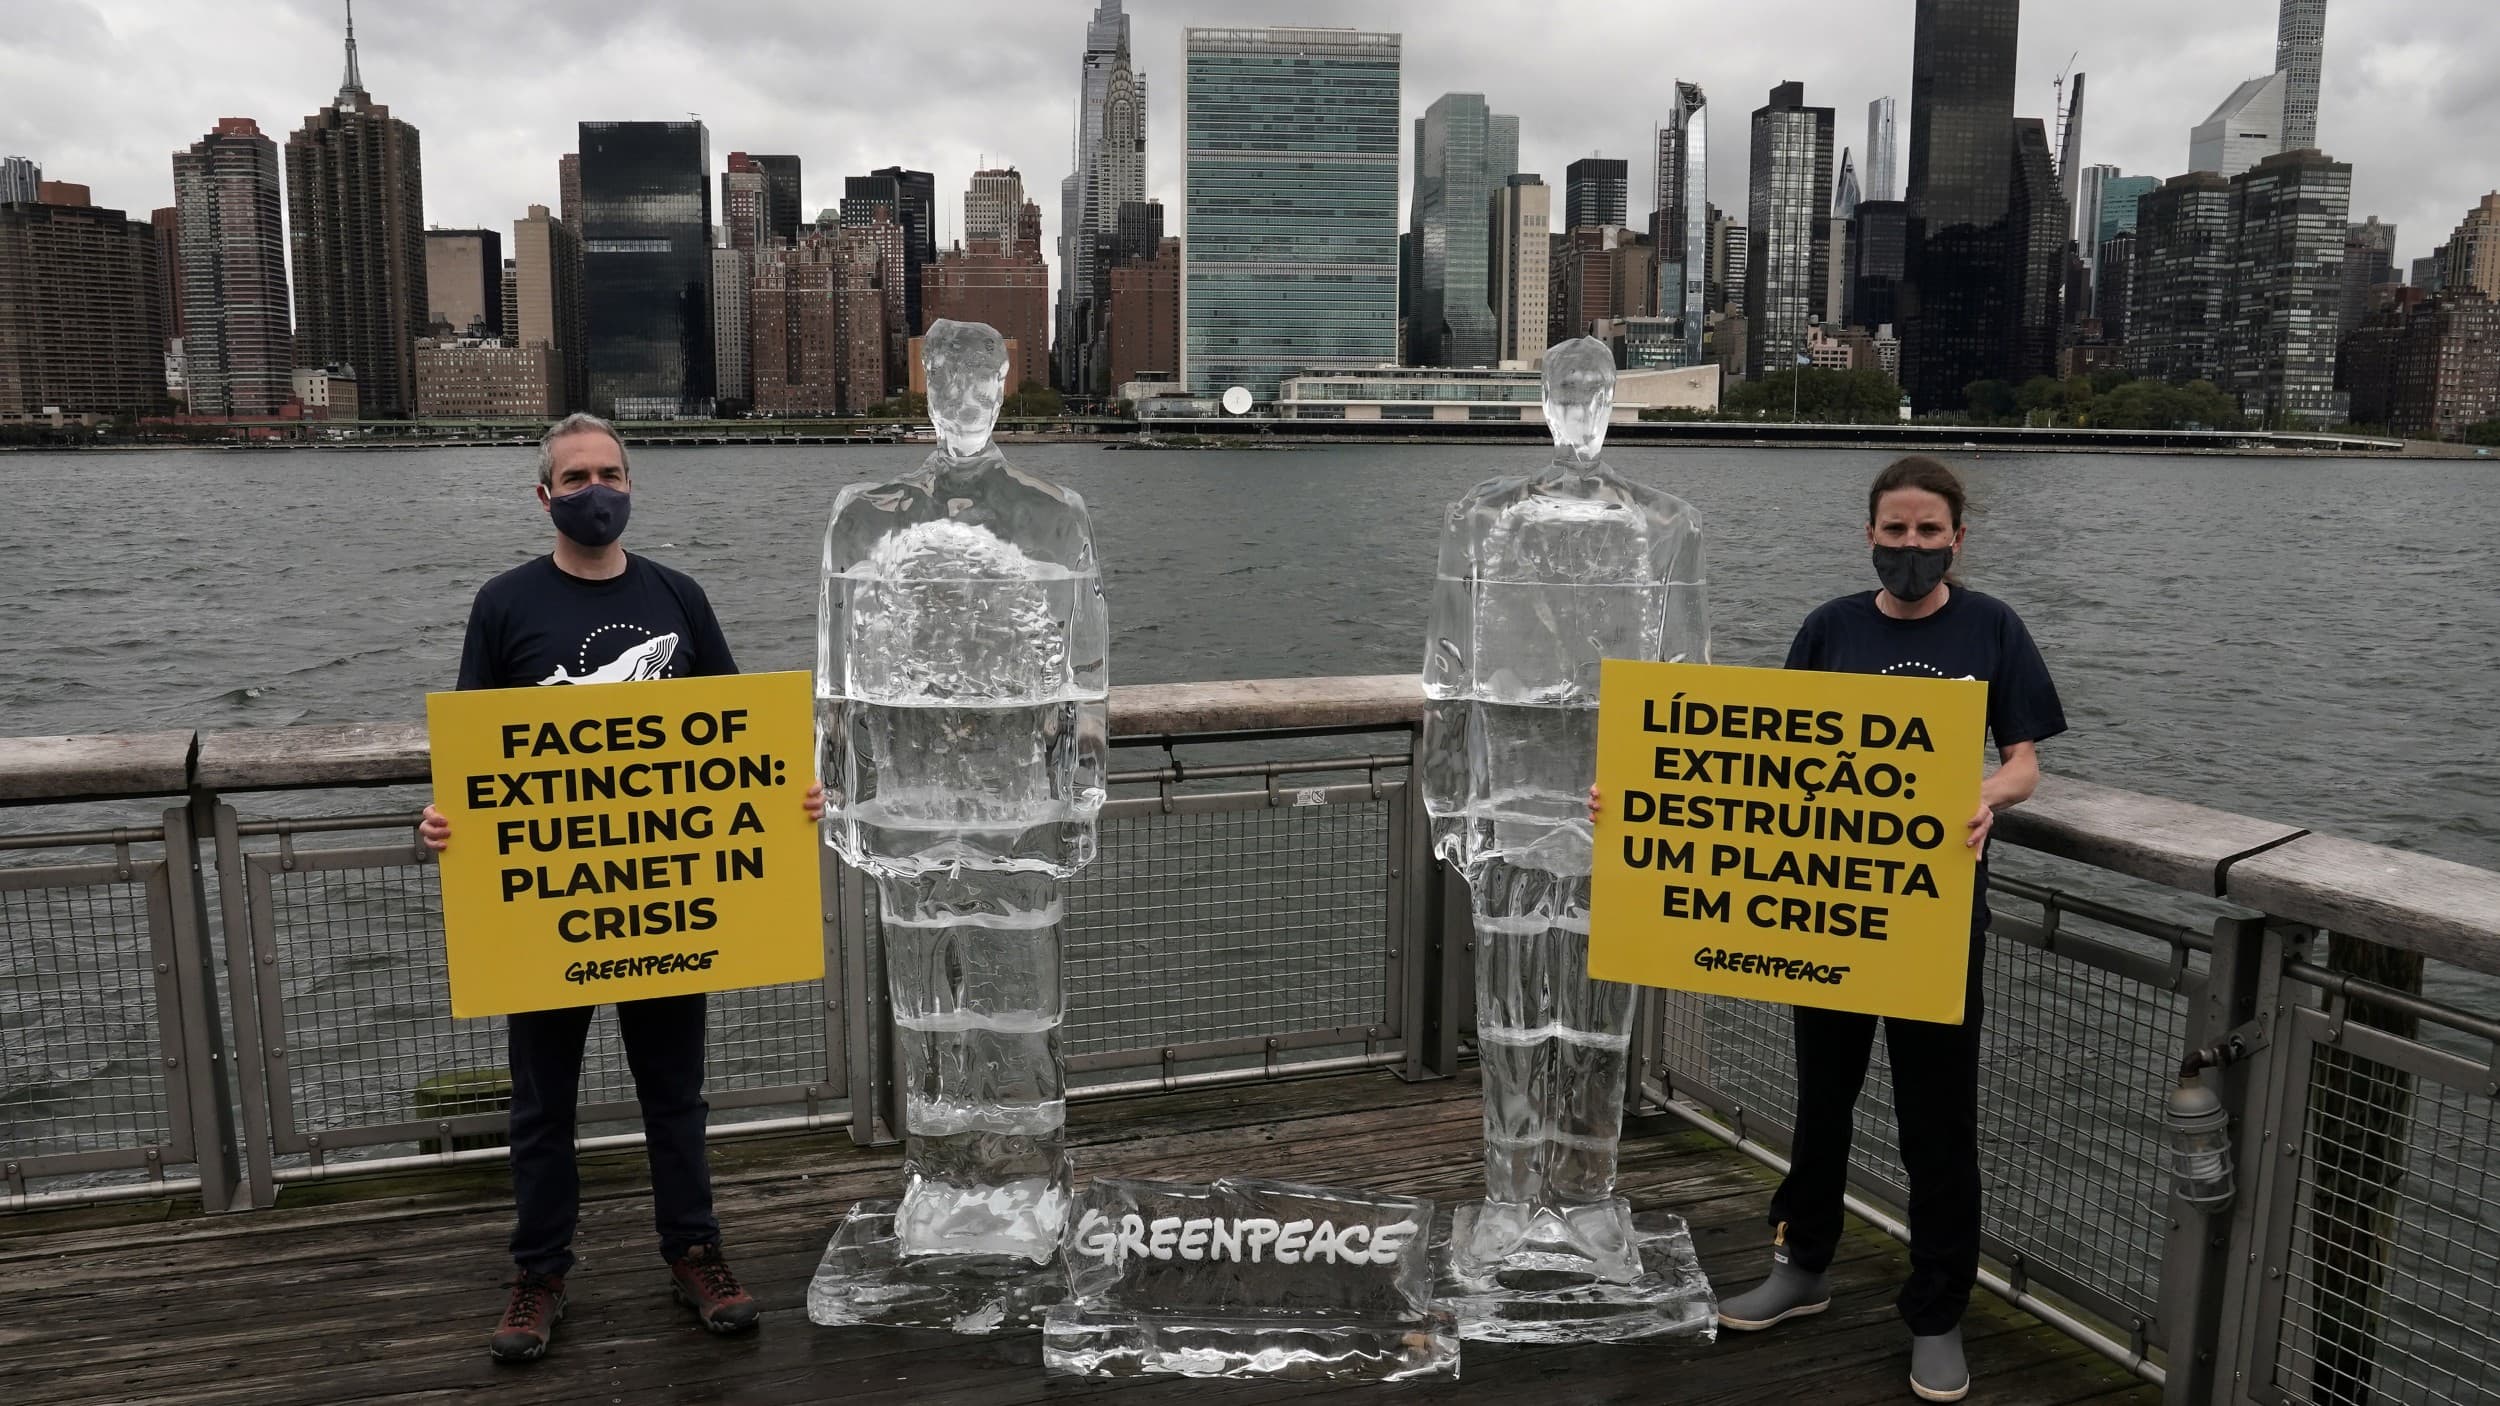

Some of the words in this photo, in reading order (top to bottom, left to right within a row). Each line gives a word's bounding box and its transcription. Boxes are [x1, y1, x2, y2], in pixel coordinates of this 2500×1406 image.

[502, 715, 666, 758] FACES
[682, 710, 747, 745] OF
[1643, 692, 1843, 745] LÍDERES
[1860, 714, 1934, 752] DA
[467, 755, 785, 809] EXTINCTION:
[1654, 747, 1917, 801] EXTINÇÃO:
[497, 806, 713, 855] FUELING
[729, 802, 764, 835] A
[1623, 790, 1944, 849] DESTRUINDO
[502, 853, 700, 902] PLANET
[716, 847, 763, 882] IN
[1623, 836, 1694, 873] UM
[1712, 844, 1939, 898] PLANETA
[558, 898, 717, 943] CRISIS
[1663, 885, 1730, 923] EM
[1747, 895, 1888, 940] CRISE
[565, 950, 718, 985] GREENPEACE
[1694, 947, 1850, 984] GREENPEACE
[1075, 1208, 1418, 1265] GREENPEACE
